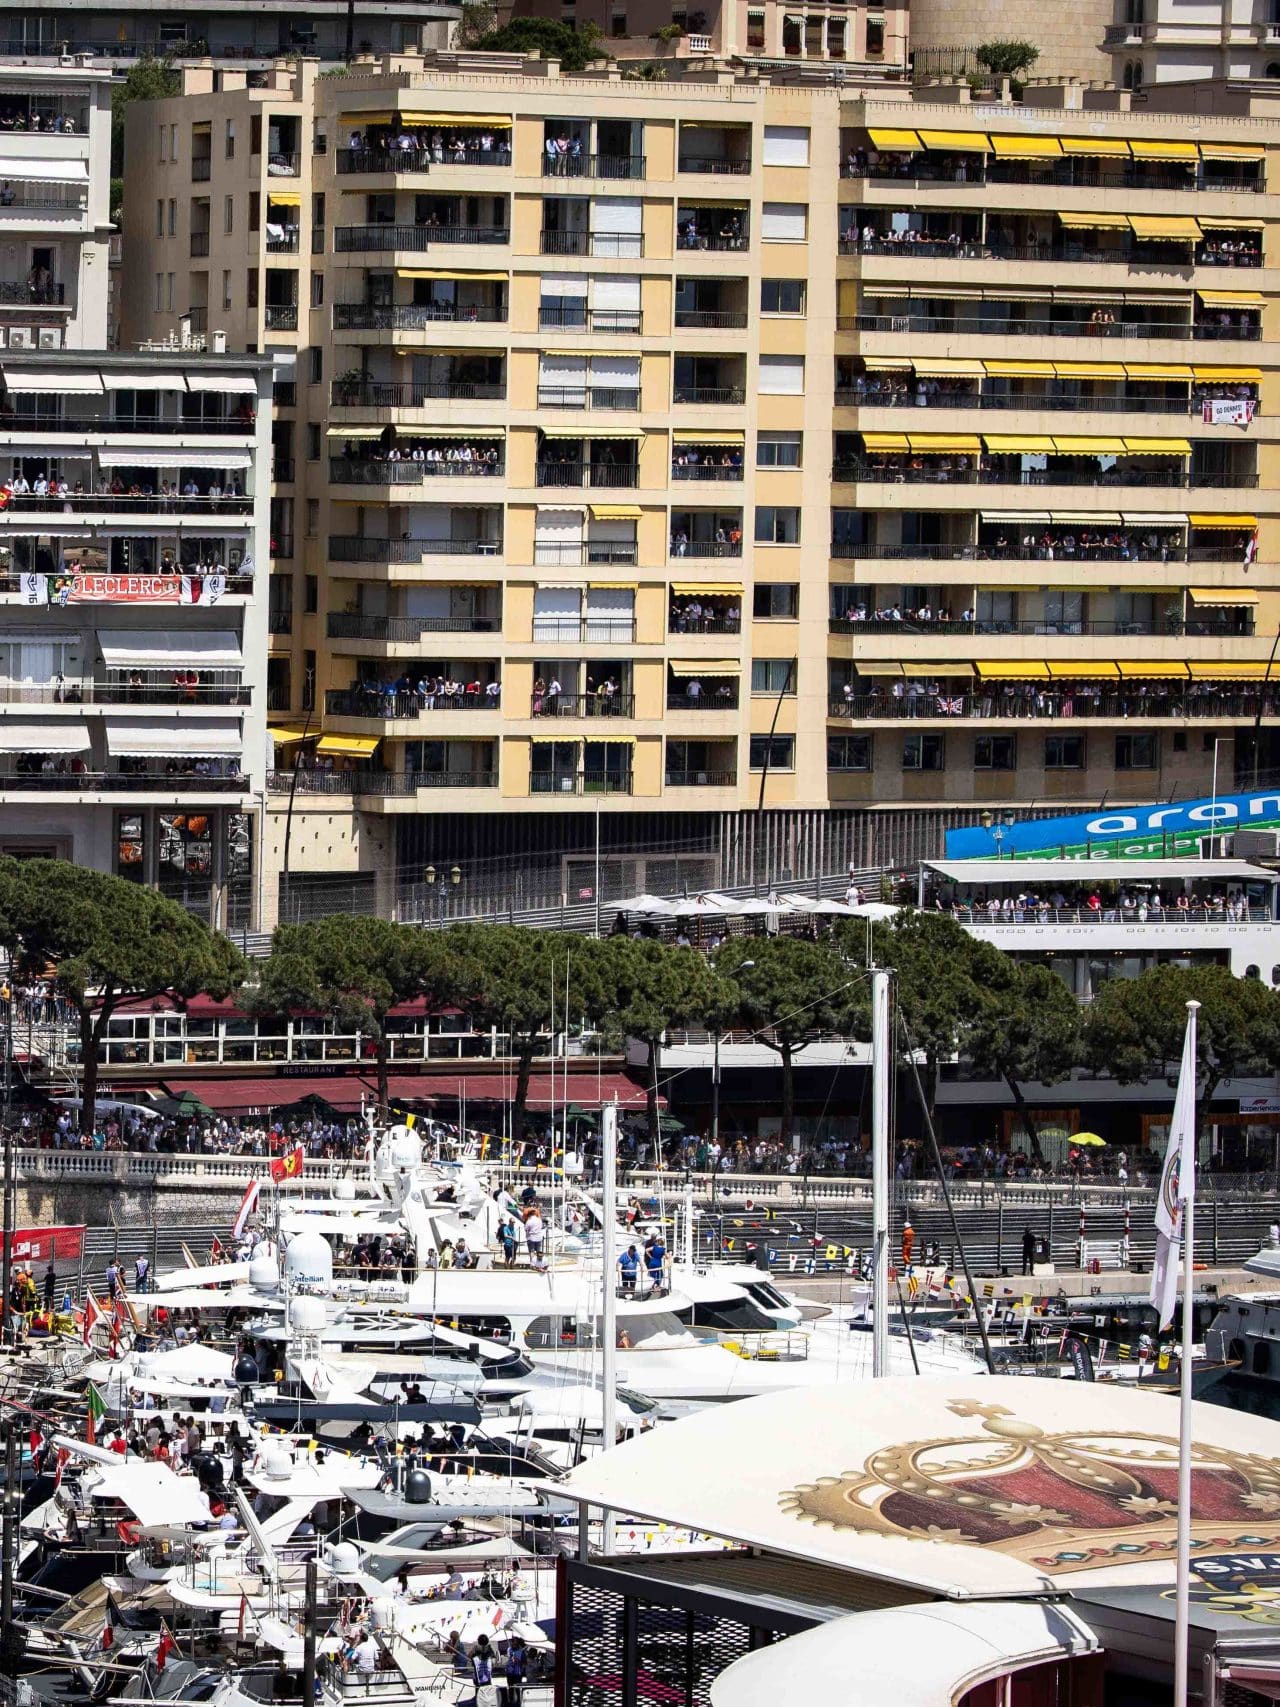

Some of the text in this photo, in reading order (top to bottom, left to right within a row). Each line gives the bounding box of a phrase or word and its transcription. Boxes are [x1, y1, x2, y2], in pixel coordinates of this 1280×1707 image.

[81, 577, 162, 594] LECLERC
[27, 592, 38, 604] 16
[282, 1066, 336, 1074] RESTAURANT
